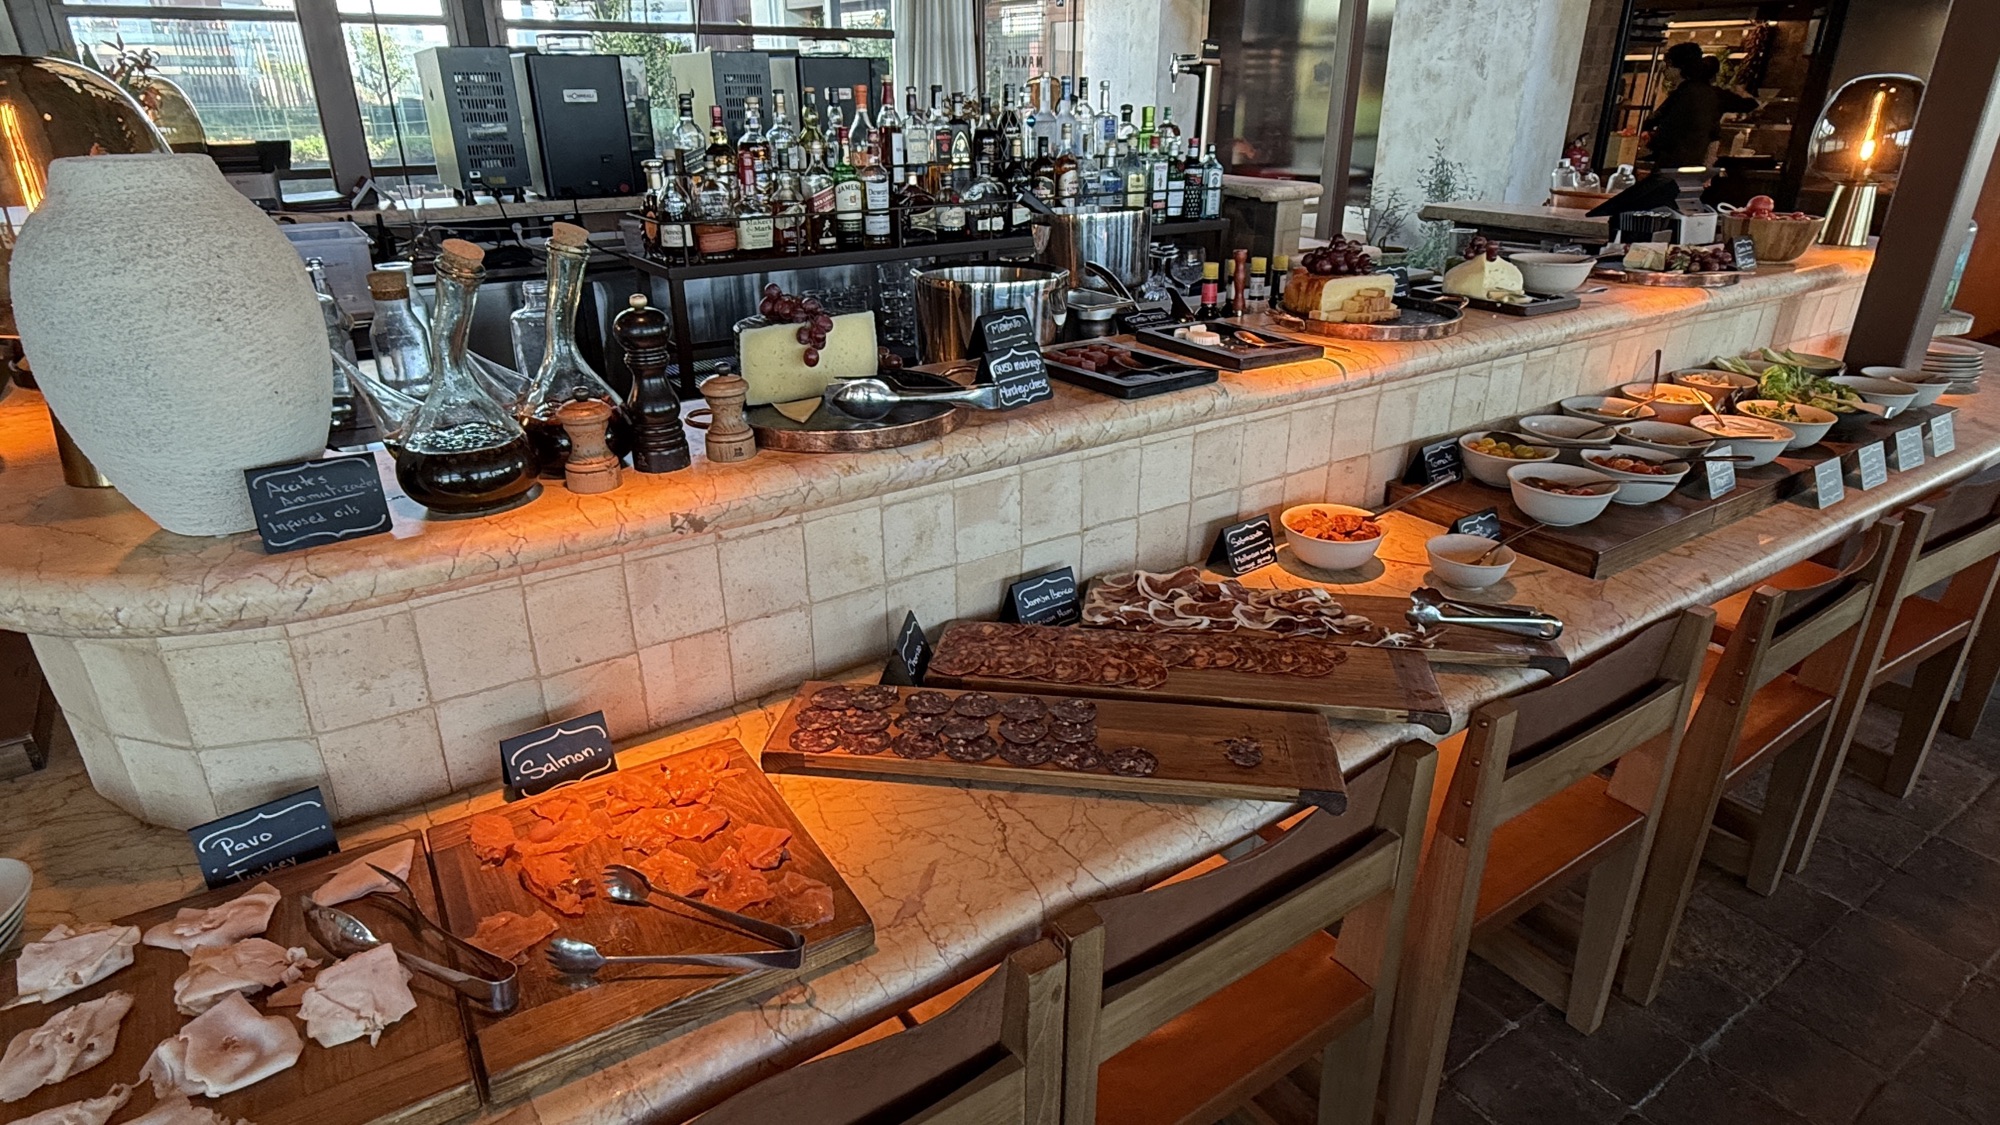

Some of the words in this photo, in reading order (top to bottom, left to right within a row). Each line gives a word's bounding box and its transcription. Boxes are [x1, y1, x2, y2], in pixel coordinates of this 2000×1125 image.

[266, 475, 327, 498] Aceites
[268, 512, 327, 534] Infused
[334, 505, 361, 518] oils
[520, 747, 595, 780] Salmon
[211, 832, 273, 857] Pavo
